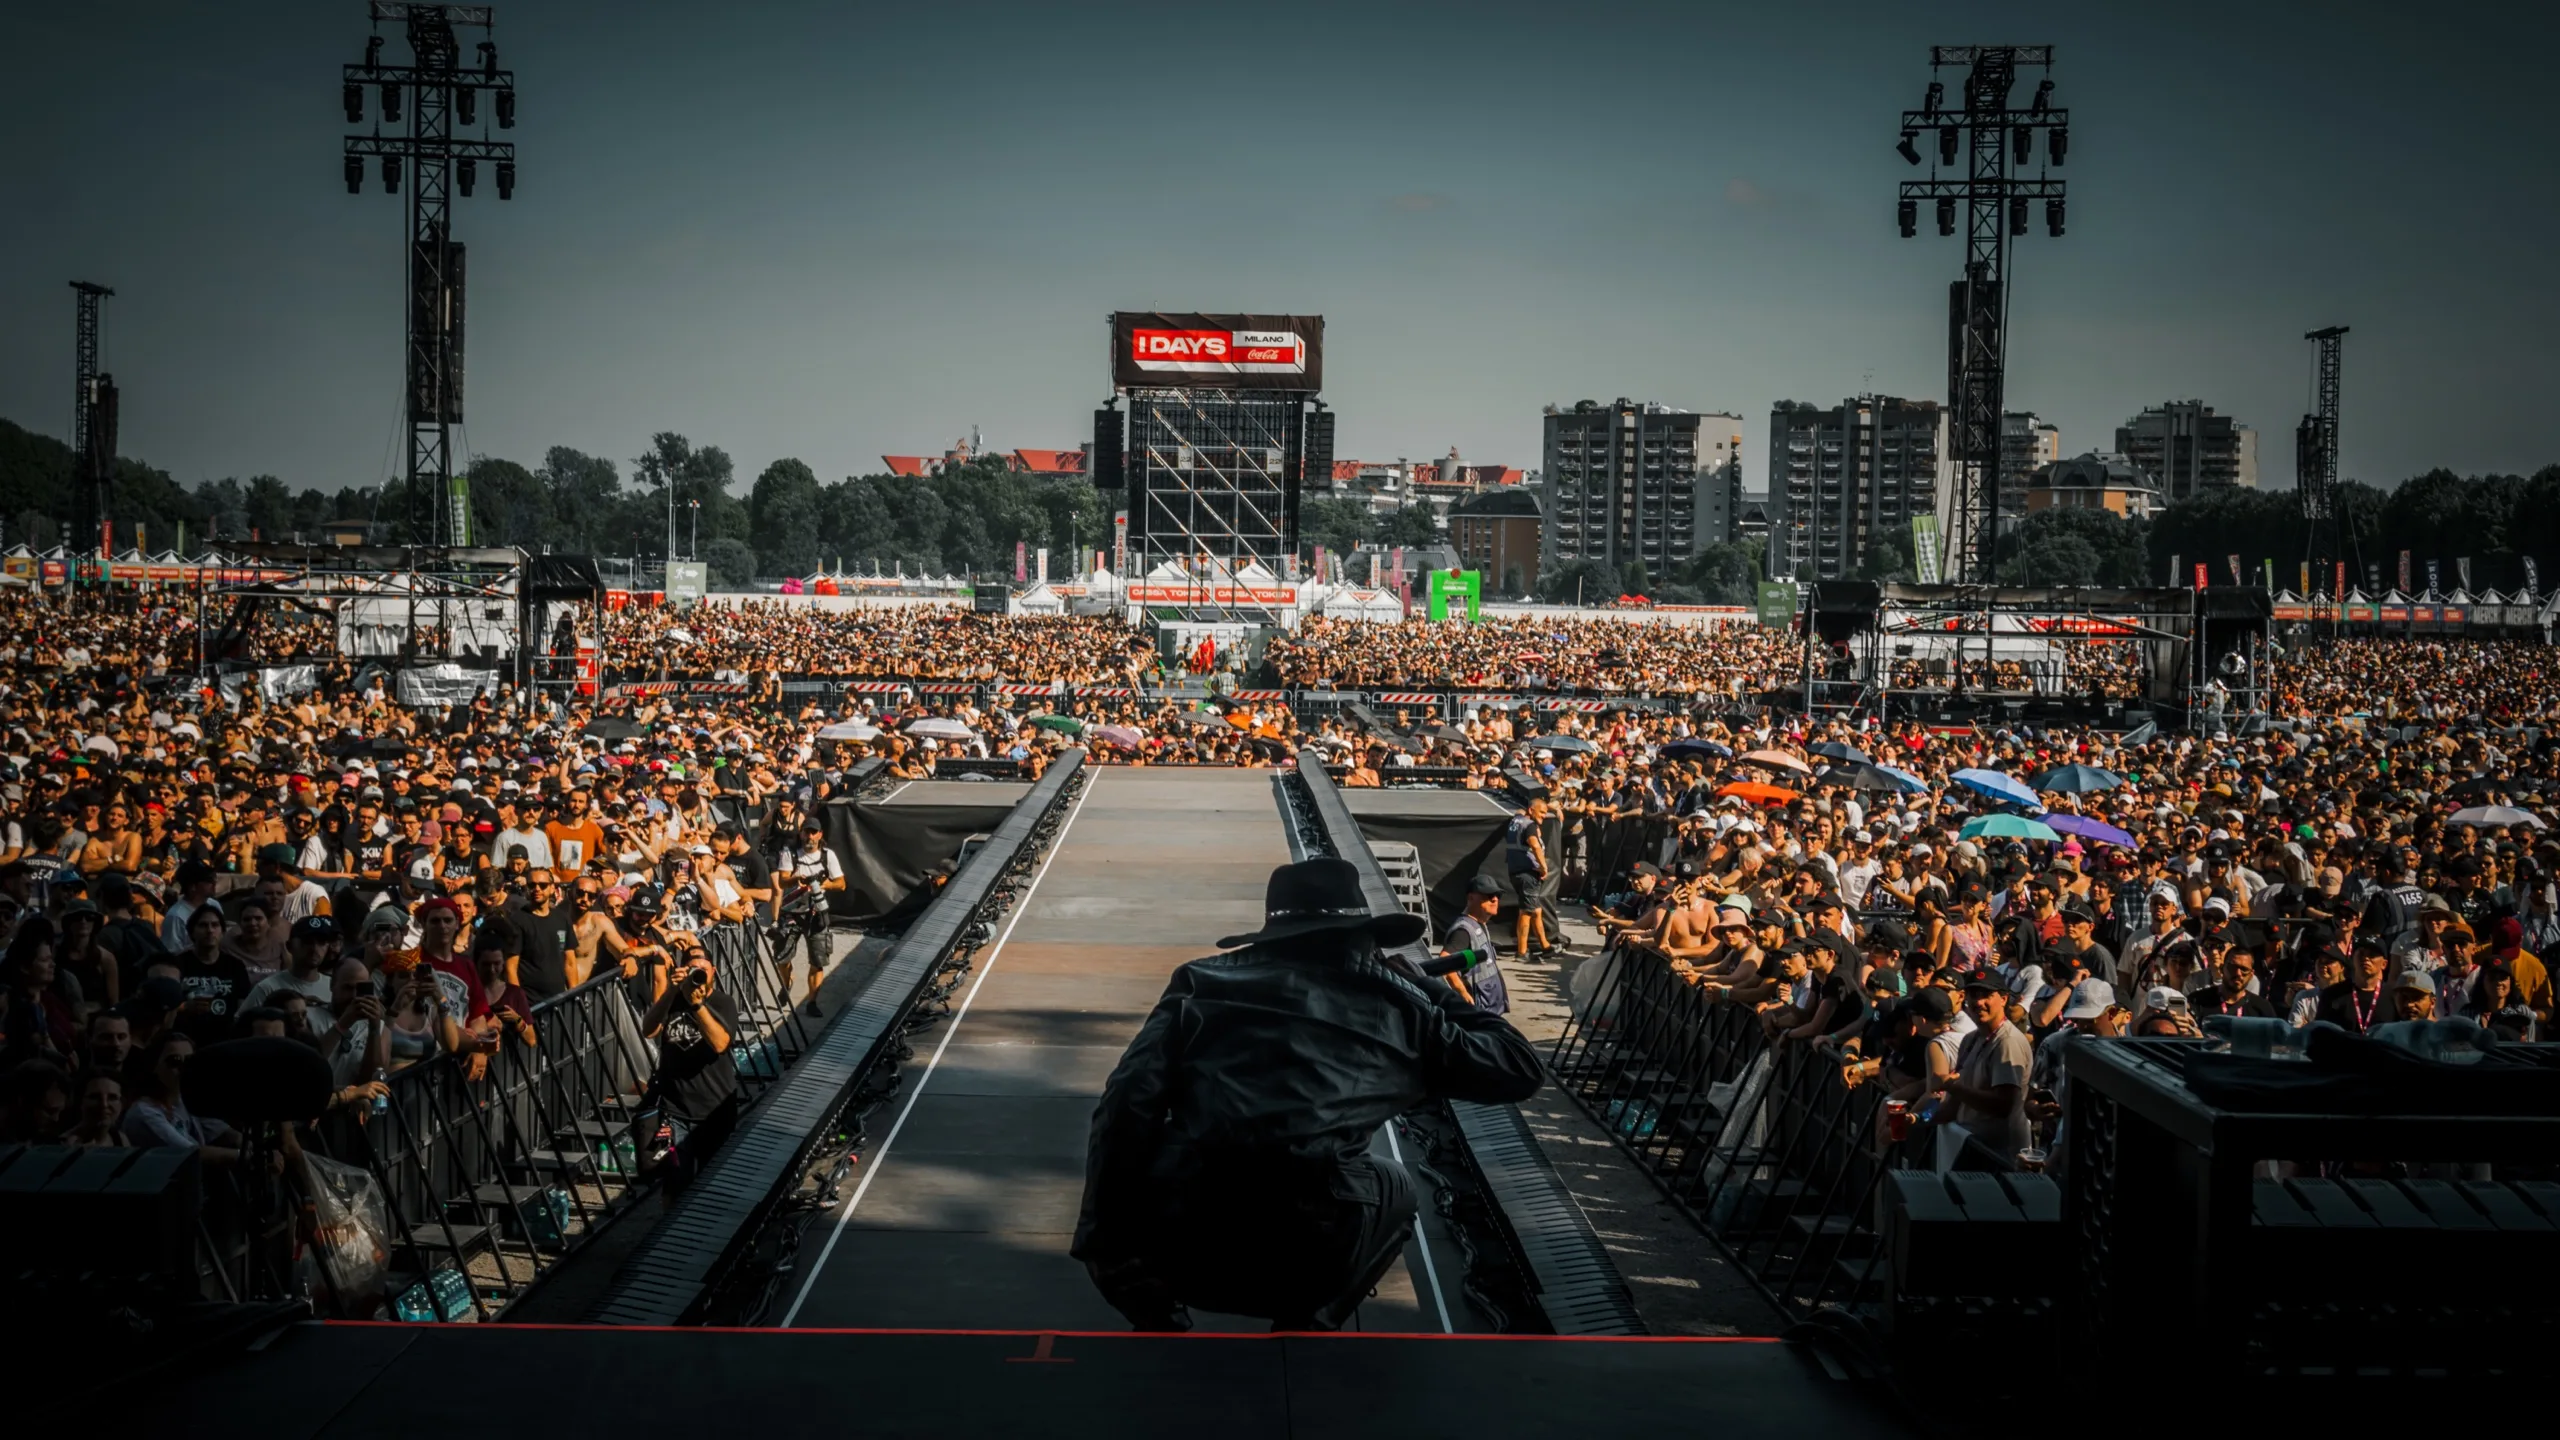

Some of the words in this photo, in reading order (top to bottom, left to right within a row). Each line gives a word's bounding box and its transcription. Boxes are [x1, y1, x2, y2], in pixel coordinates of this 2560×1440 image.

[1150, 337, 1227, 355] DAYS
[1244, 335, 1284, 343] MILANO
[2474, 607, 2498, 624] MERCH
[2506, 607, 2533, 625] MERCH
[2399, 892, 2423, 906] 1655
